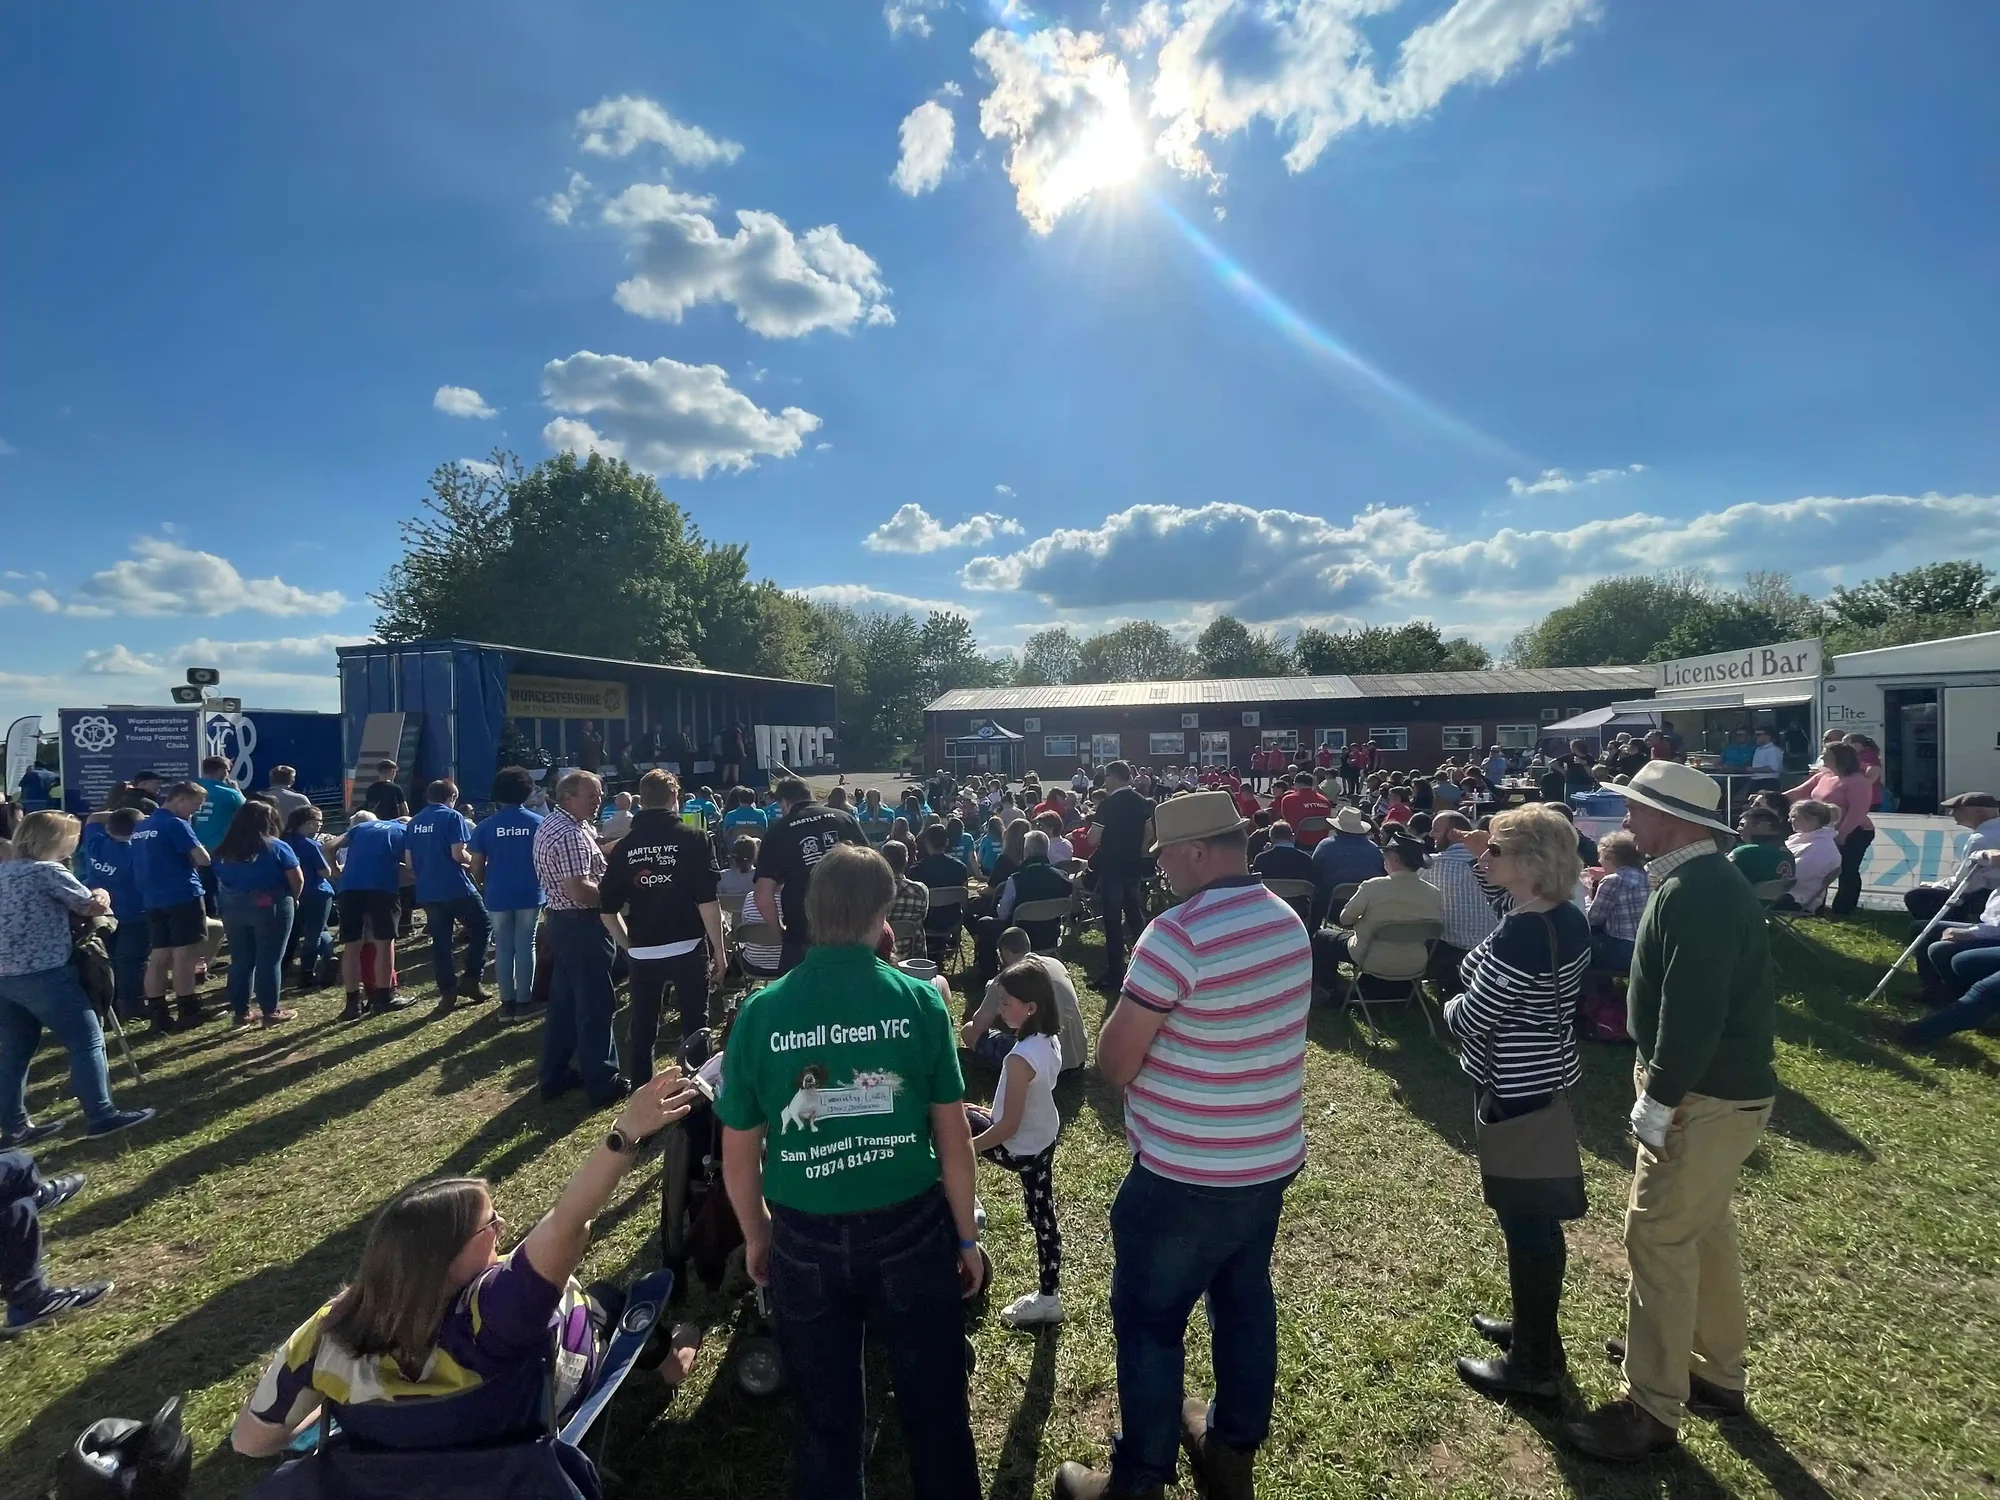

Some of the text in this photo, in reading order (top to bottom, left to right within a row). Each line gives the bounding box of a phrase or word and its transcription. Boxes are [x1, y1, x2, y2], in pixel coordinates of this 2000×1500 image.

[1663, 649, 1808, 687] Licensed Bar
[510, 689, 602, 705] WORCESTERSHIRE
[127, 717, 189, 725] Worcestershire
[1827, 705, 1867, 722] Elite
[789, 814, 822, 828] MARTLEY
[130, 829, 158, 840] eorge
[496, 827, 530, 838] Brian
[627, 845, 679, 858] MARTLEY YFC
[628, 852, 675, 865] County Show
[90, 857, 117, 876] Toby
[640, 874, 672, 888] apex
[770, 1018, 910, 1052] Cutnall Green YFC
[781, 1132, 917, 1162] Sam Newell Transport
[806, 1158, 845, 1179] 07874
